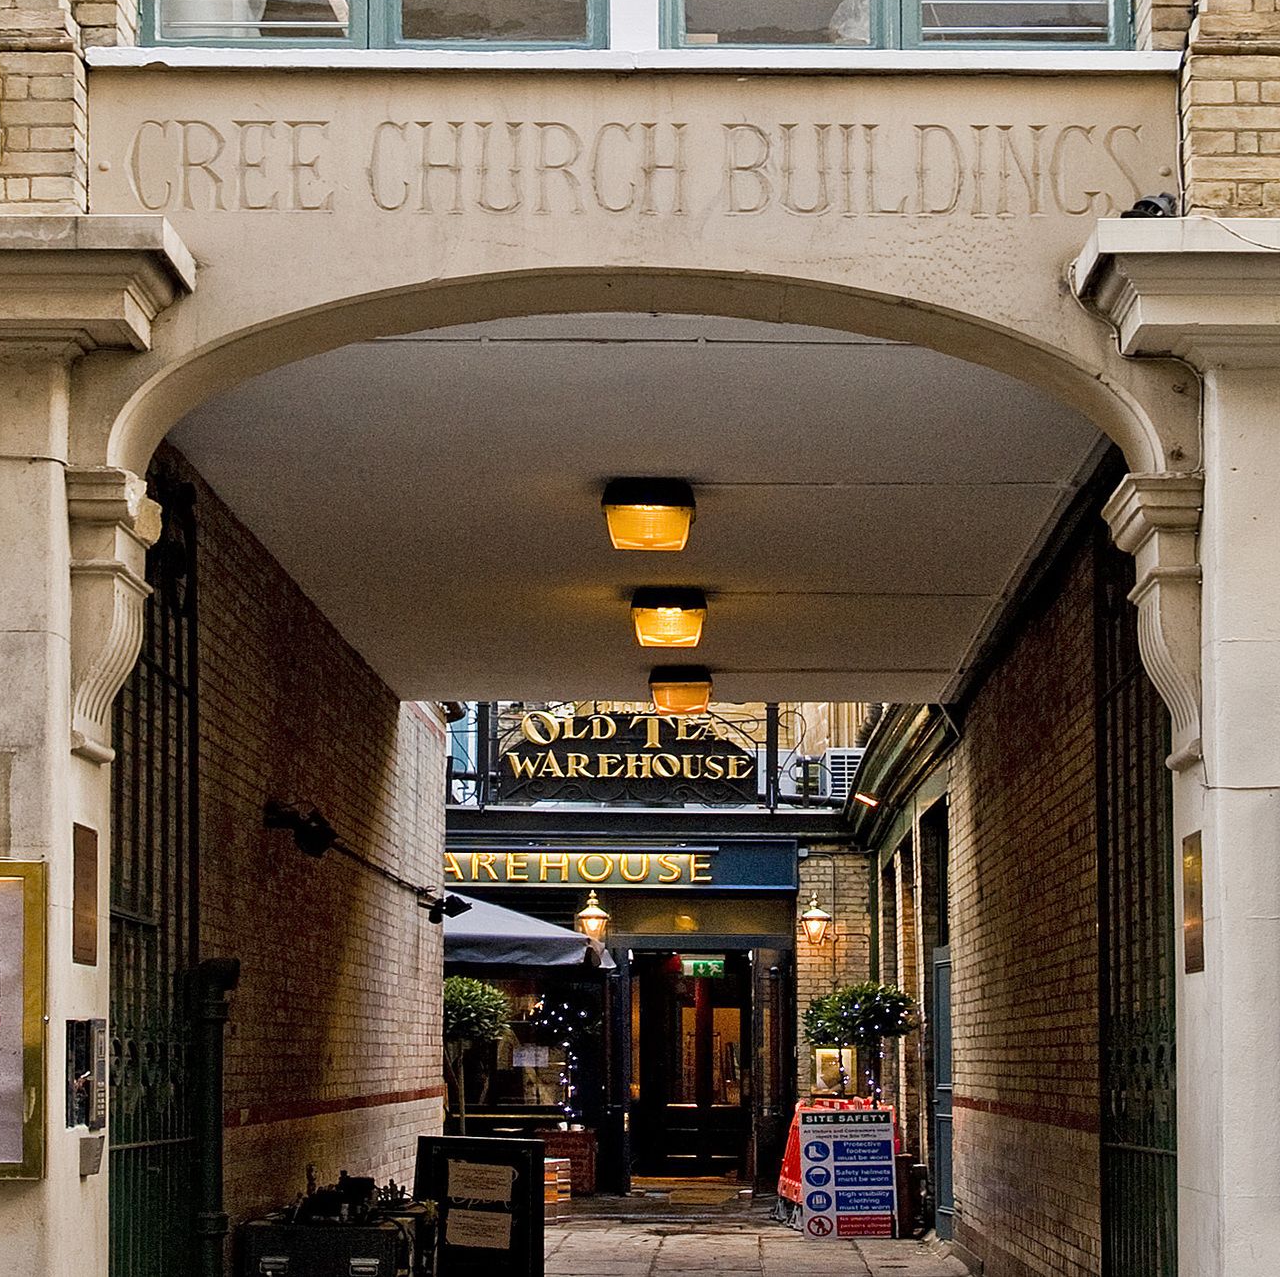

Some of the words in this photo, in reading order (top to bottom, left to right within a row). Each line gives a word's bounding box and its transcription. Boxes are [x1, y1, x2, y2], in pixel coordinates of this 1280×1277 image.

[126, 120, 334, 215] CREE
[366, 120, 688, 218] CHURCH
[722, 122, 1144, 220] BUILDINGS
[521, 710, 616, 745] OLD
[628, 714, 727, 749] TEA
[507, 748, 754, 780] WAREHOUSE
